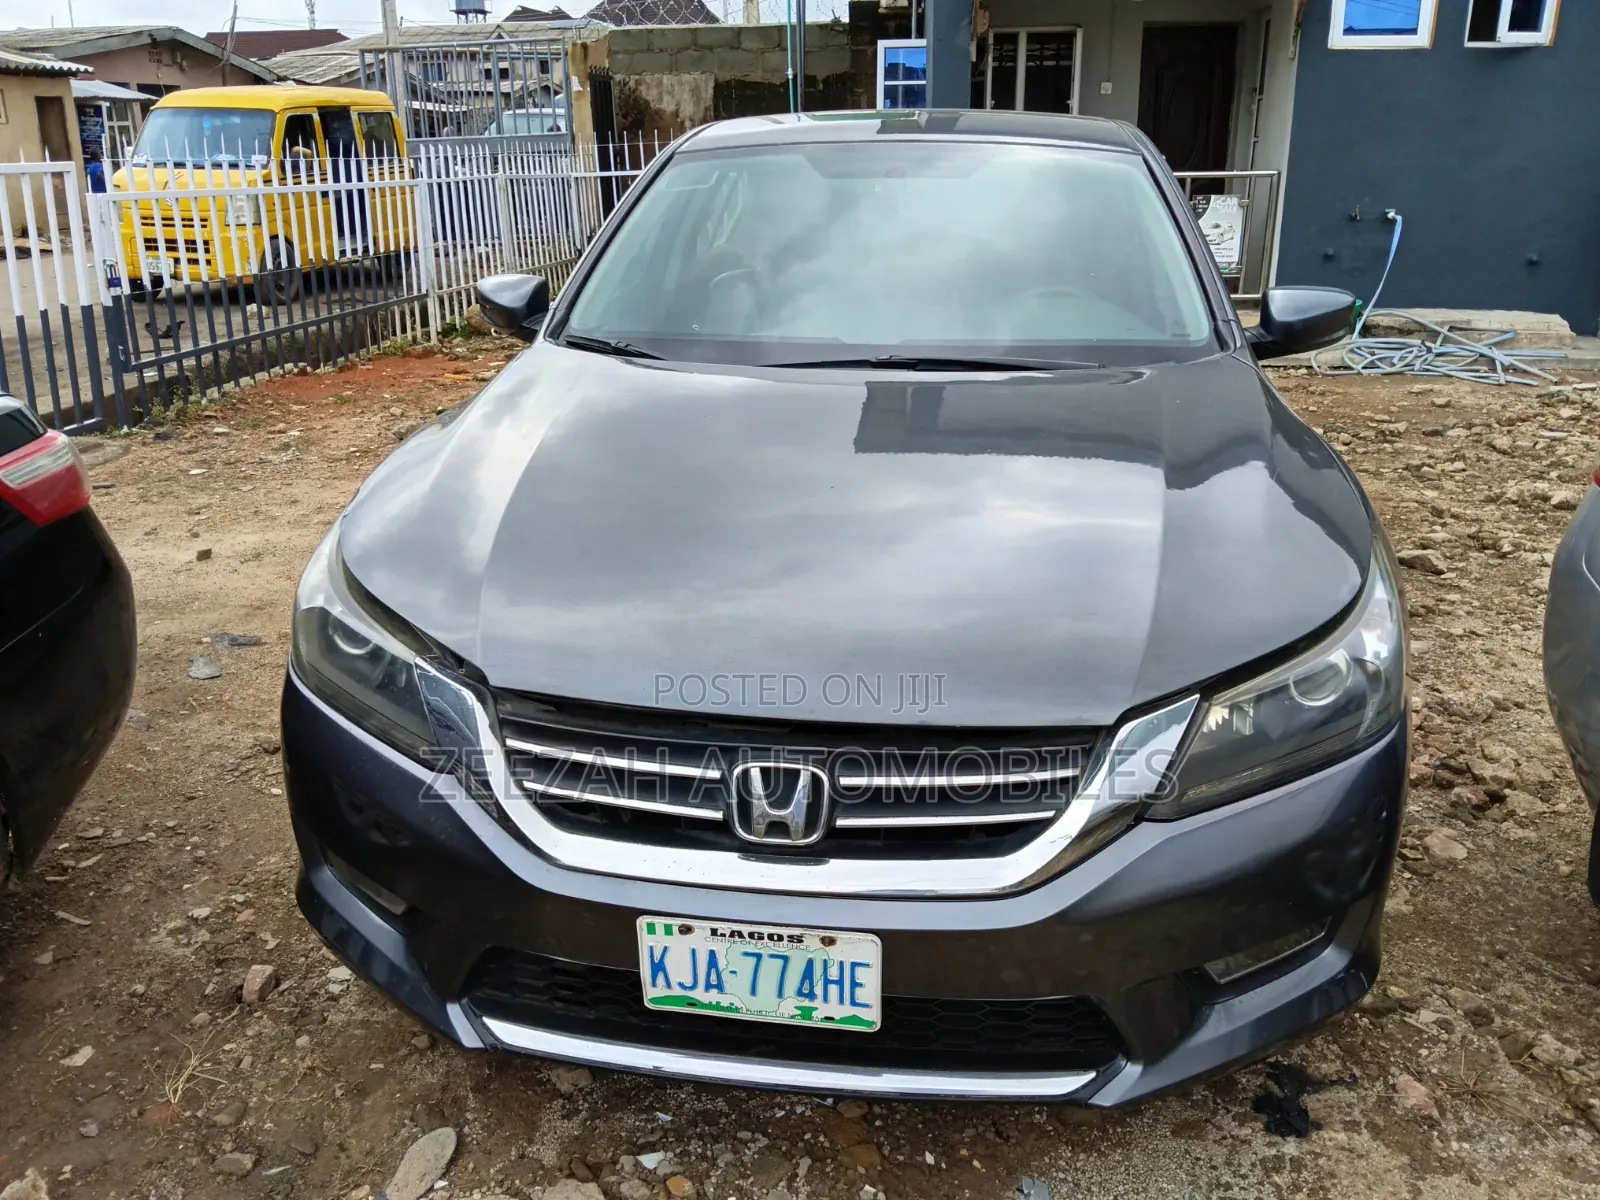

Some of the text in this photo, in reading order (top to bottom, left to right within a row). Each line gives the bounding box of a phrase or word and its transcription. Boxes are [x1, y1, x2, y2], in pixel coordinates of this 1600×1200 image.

[1219, 196, 1238, 205] CAR
[1218, 205, 1238, 213] SALE
[709, 927, 804, 944] LAGOS
[704, 936, 738, 945] CENTRE
[647, 944, 873, 1009] KJA-774HE
